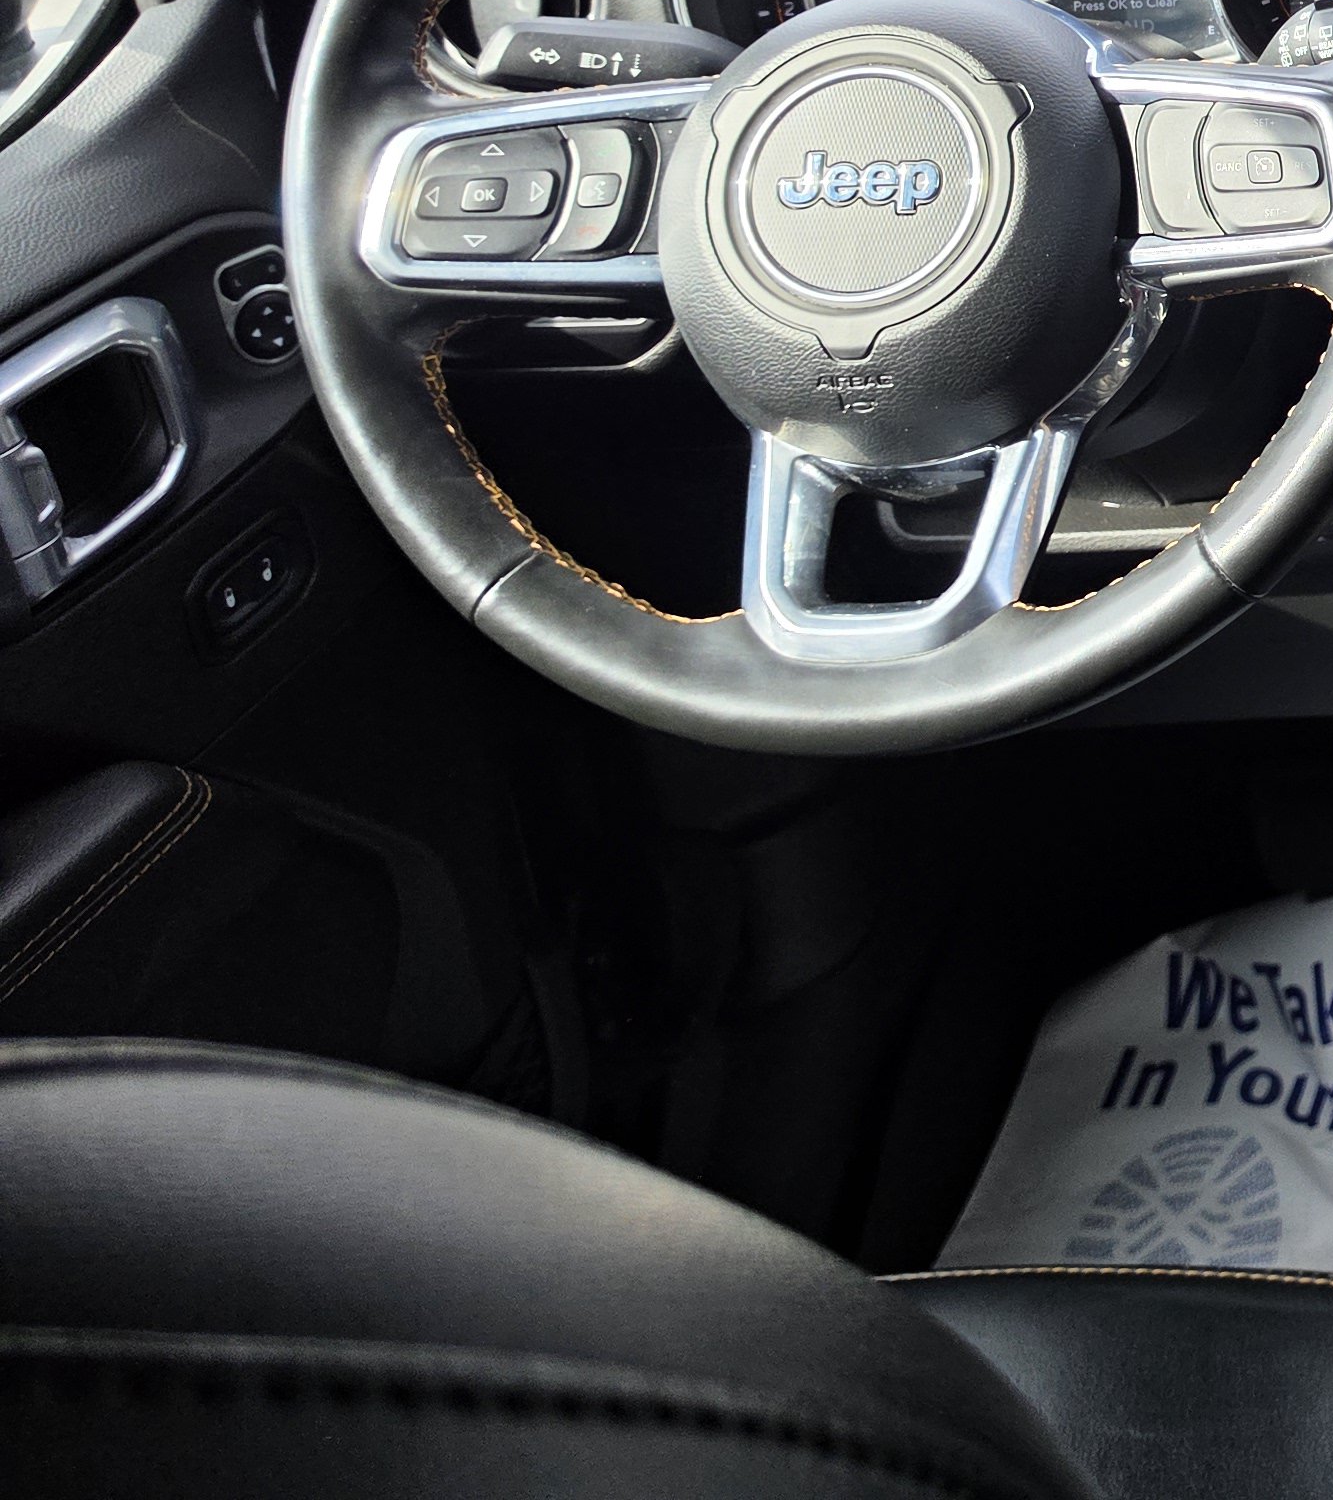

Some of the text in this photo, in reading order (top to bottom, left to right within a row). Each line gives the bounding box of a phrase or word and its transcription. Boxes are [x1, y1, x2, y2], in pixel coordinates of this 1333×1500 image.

[784, 1, 794, 16] 2
[1074, 0, 1105, 12] Press
[1108, 0, 1129, 11] OK
[1130, 0, 1143, 9] to
[1294, 45, 1308, 57] OFF
[1215, 162, 1242, 172] CANC
[777, 150, 944, 216] Jeep
[474, 187, 496, 203] OK
[1165, 950, 1258, 1034] We
[1098, 1045, 1179, 1111] In
